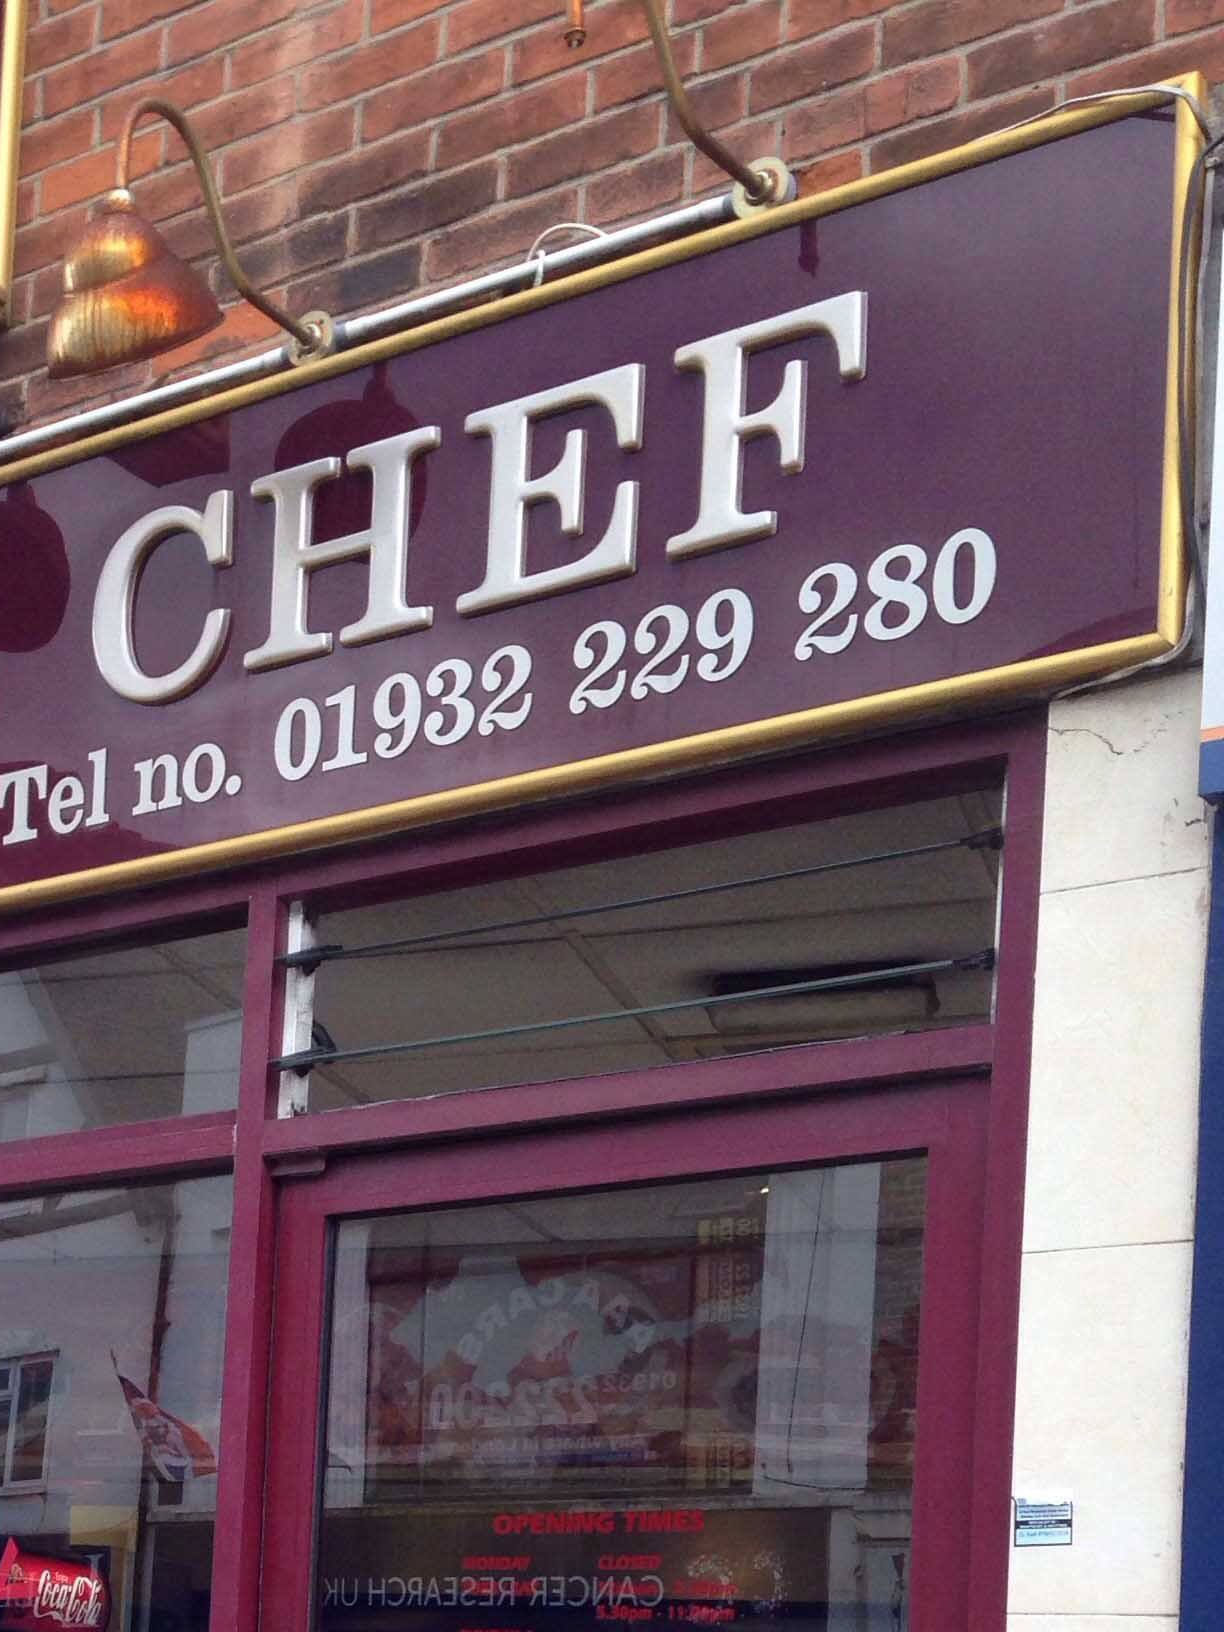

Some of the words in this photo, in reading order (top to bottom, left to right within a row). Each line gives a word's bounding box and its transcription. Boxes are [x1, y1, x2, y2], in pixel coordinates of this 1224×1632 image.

[91, 289, 869, 706] CHEF
[133, 741, 243, 813] no.
[273, 643, 535, 781] 01932
[569, 587, 755, 714] 229
[791, 526, 998, 662] 280
[493, 1512, 615, 1536] OPENING
[623, 1509, 706, 1533] TIMES
